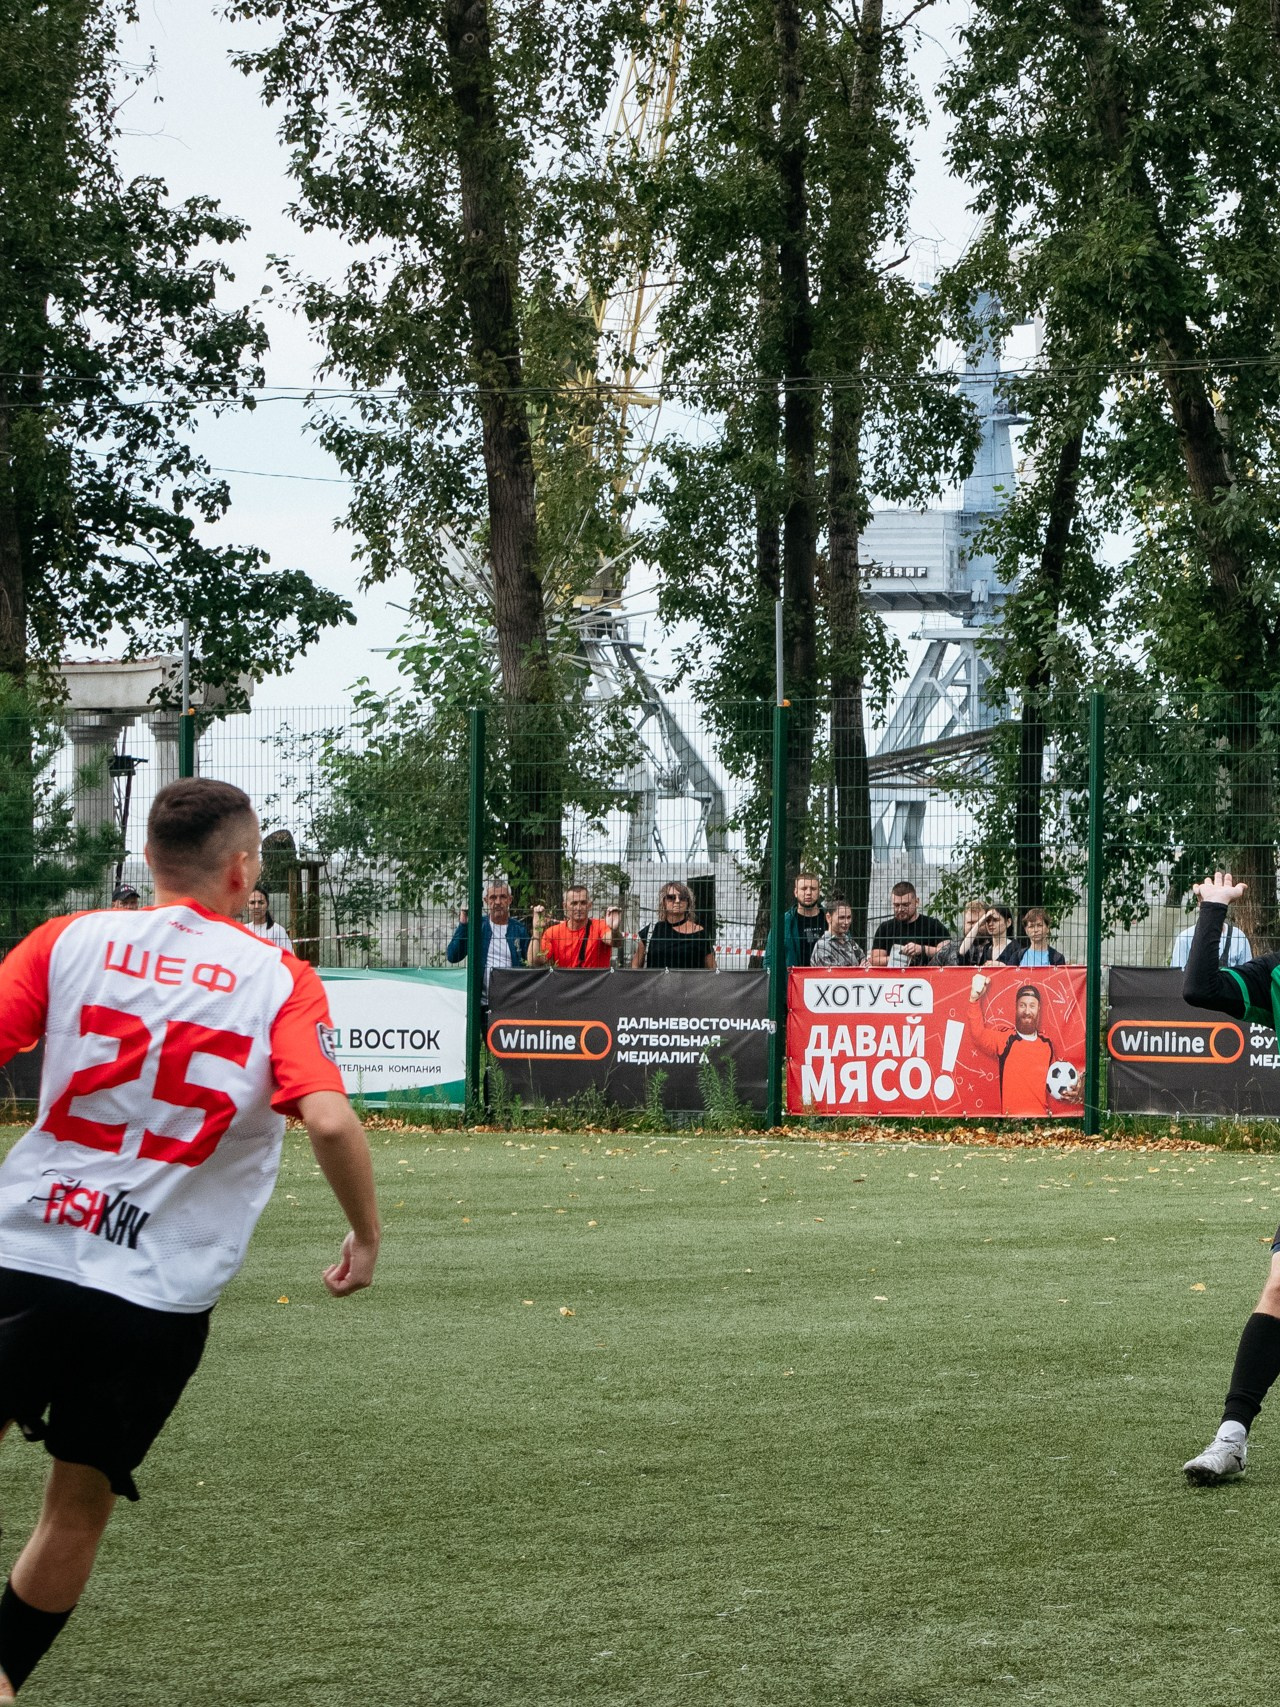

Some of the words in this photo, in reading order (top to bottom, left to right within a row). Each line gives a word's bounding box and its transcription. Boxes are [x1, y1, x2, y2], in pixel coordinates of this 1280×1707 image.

[104, 941, 237, 993] ШЕФ
[617, 1017, 770, 1032] ДАЛЬНЕВОСТОЧНАЯ
[349, 1028, 440, 1050] ВОСТОК
[499, 1029, 576, 1051] Winline
[617, 1034, 721, 1047] ФУТБОЛЬНАЯ
[805, 1015, 925, 1065] ДАВАЙ
[1120, 1030, 1205, 1053] Winline
[388, 1065, 441, 1073] КОМПАНИЯ
[617, 1051, 710, 1065] МЕДИАЛИГА
[41, 1004, 253, 1167] 25
